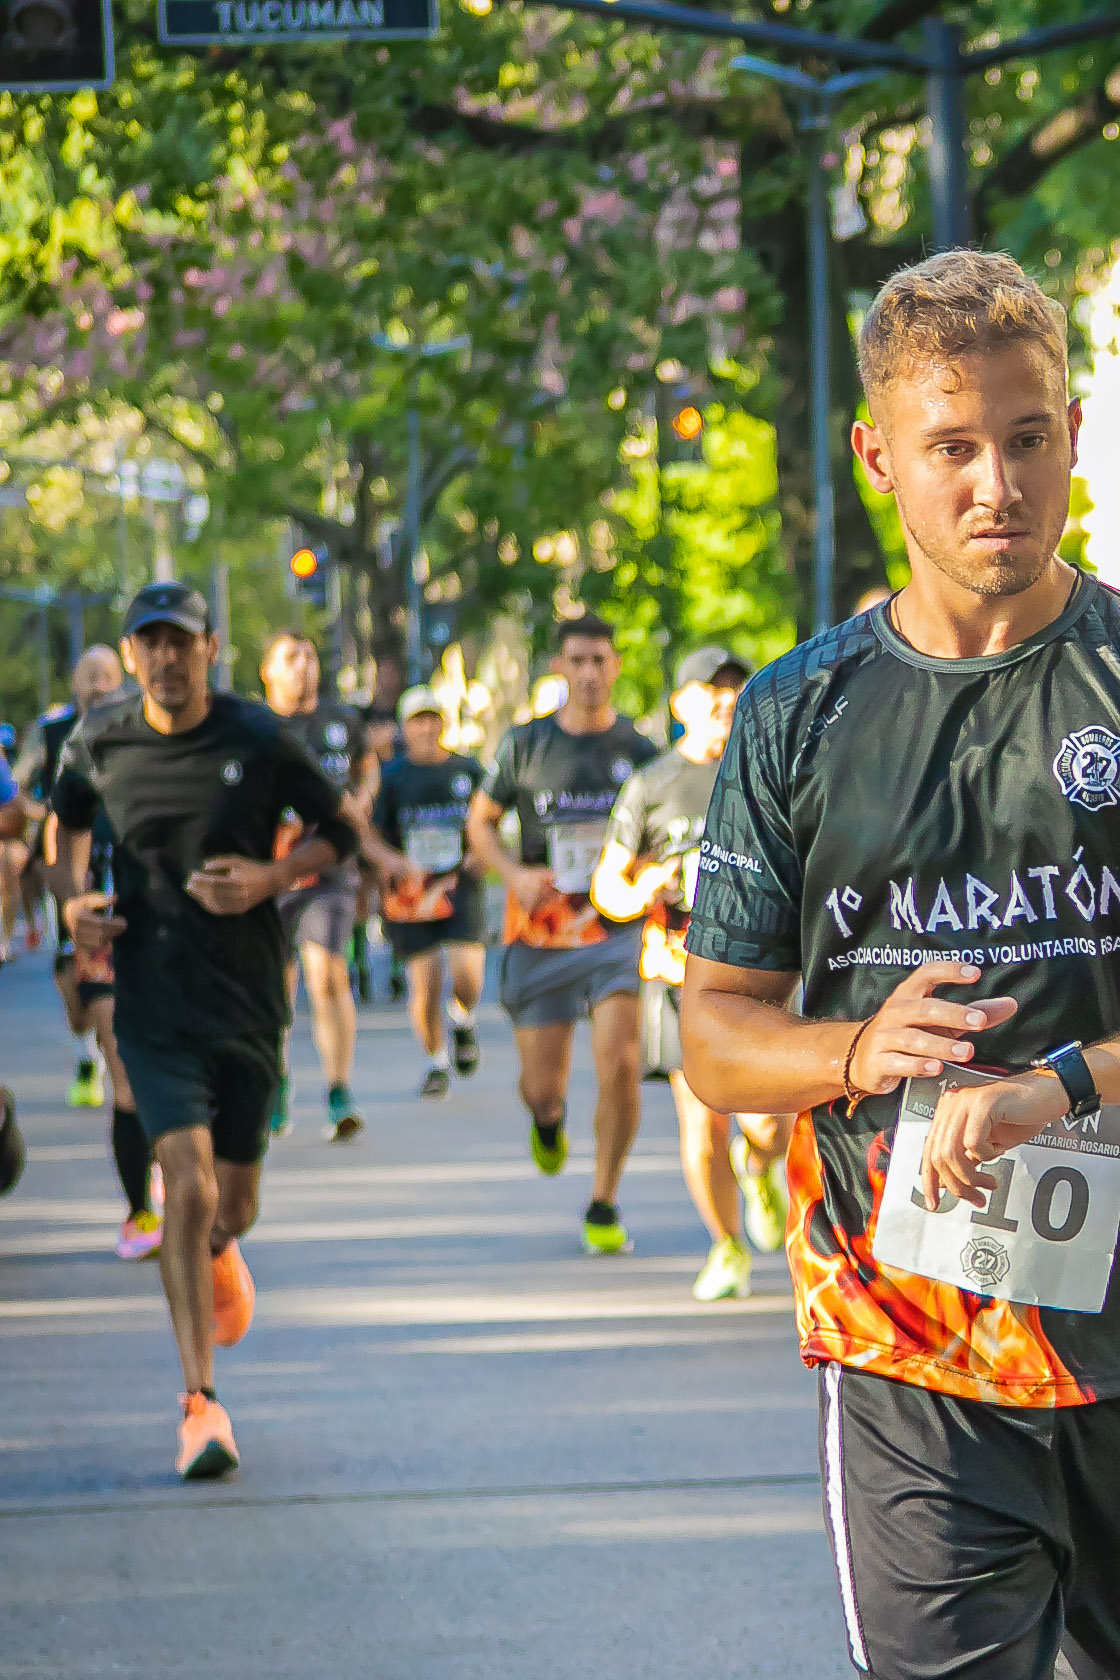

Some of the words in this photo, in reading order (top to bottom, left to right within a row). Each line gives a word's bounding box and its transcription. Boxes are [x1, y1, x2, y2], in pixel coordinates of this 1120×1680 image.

[1081, 751, 1112, 779] 27
[827, 943, 901, 971] ASOCIACIÓN
[988, 936, 1097, 964] VOLUNTARIOS
[1080, 1139, 1120, 1156] ROSARIO
[975, 1250, 997, 1270] 27
